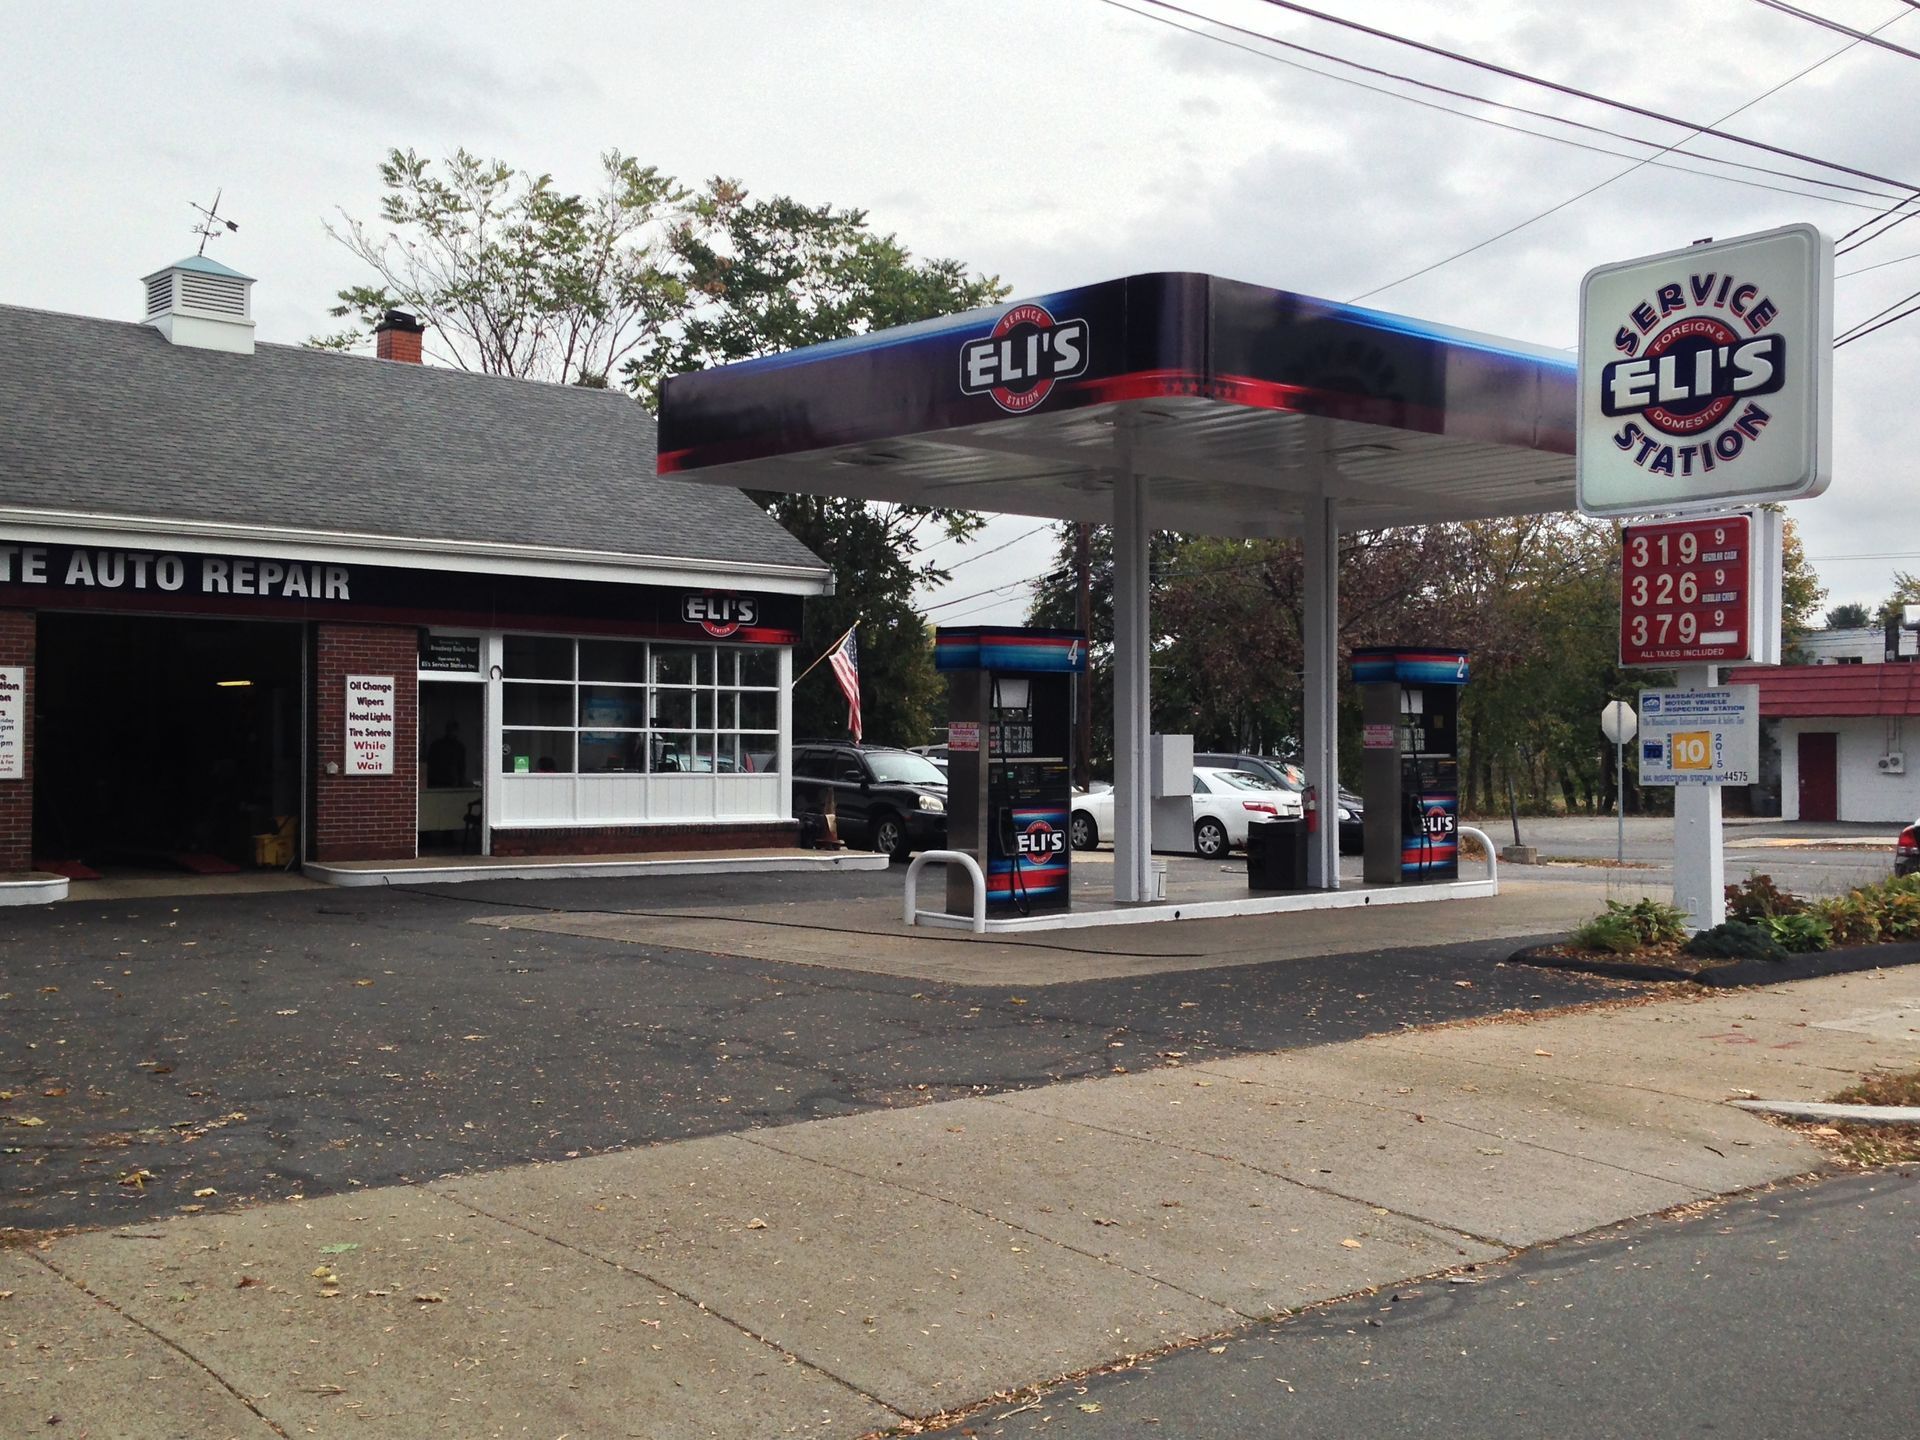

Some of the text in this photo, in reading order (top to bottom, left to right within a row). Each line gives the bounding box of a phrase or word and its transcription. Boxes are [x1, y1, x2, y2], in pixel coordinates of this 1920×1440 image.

[1004, 309, 1042, 329] SERVICE
[1615, 272, 1780, 357] SERVICE
[1654, 322, 1725, 352] FOREIGN &
[967, 327, 1081, 387] ELI'S
[1610, 339, 1774, 410] ELI'S
[1007, 391, 1039, 406] STATION
[1653, 401, 1724, 429] DOMESTIC
[1613, 401, 1773, 477] STATION
[1715, 528, 1725, 545] 9
[65, 551, 185, 591] AUTO
[202, 558, 350, 600] REPAIR
[1631, 569, 1725, 607] 326 9
[687, 597, 754, 622] ELI'S
[1631, 609, 1725, 647] 379 9
[1067, 640, 1079, 665] 4
[1641, 650, 1654, 658] ALL
[1683, 648, 1725, 657] INCLUDED
[1457, 656, 1465, 678] 2
[349, 681, 392, 693] Oil Change
[357, 697, 384, 708] Wipers
[349, 712, 392, 723] Head Lights
[349, 728, 391, 737] Tire Service
[353, 741, 386, 750] While
[1676, 739, 1705, 763] 10
[357, 762, 382, 770] Wait
[1724, 771, 1748, 781] 44575
[1017, 833, 1063, 852] ELI'S
